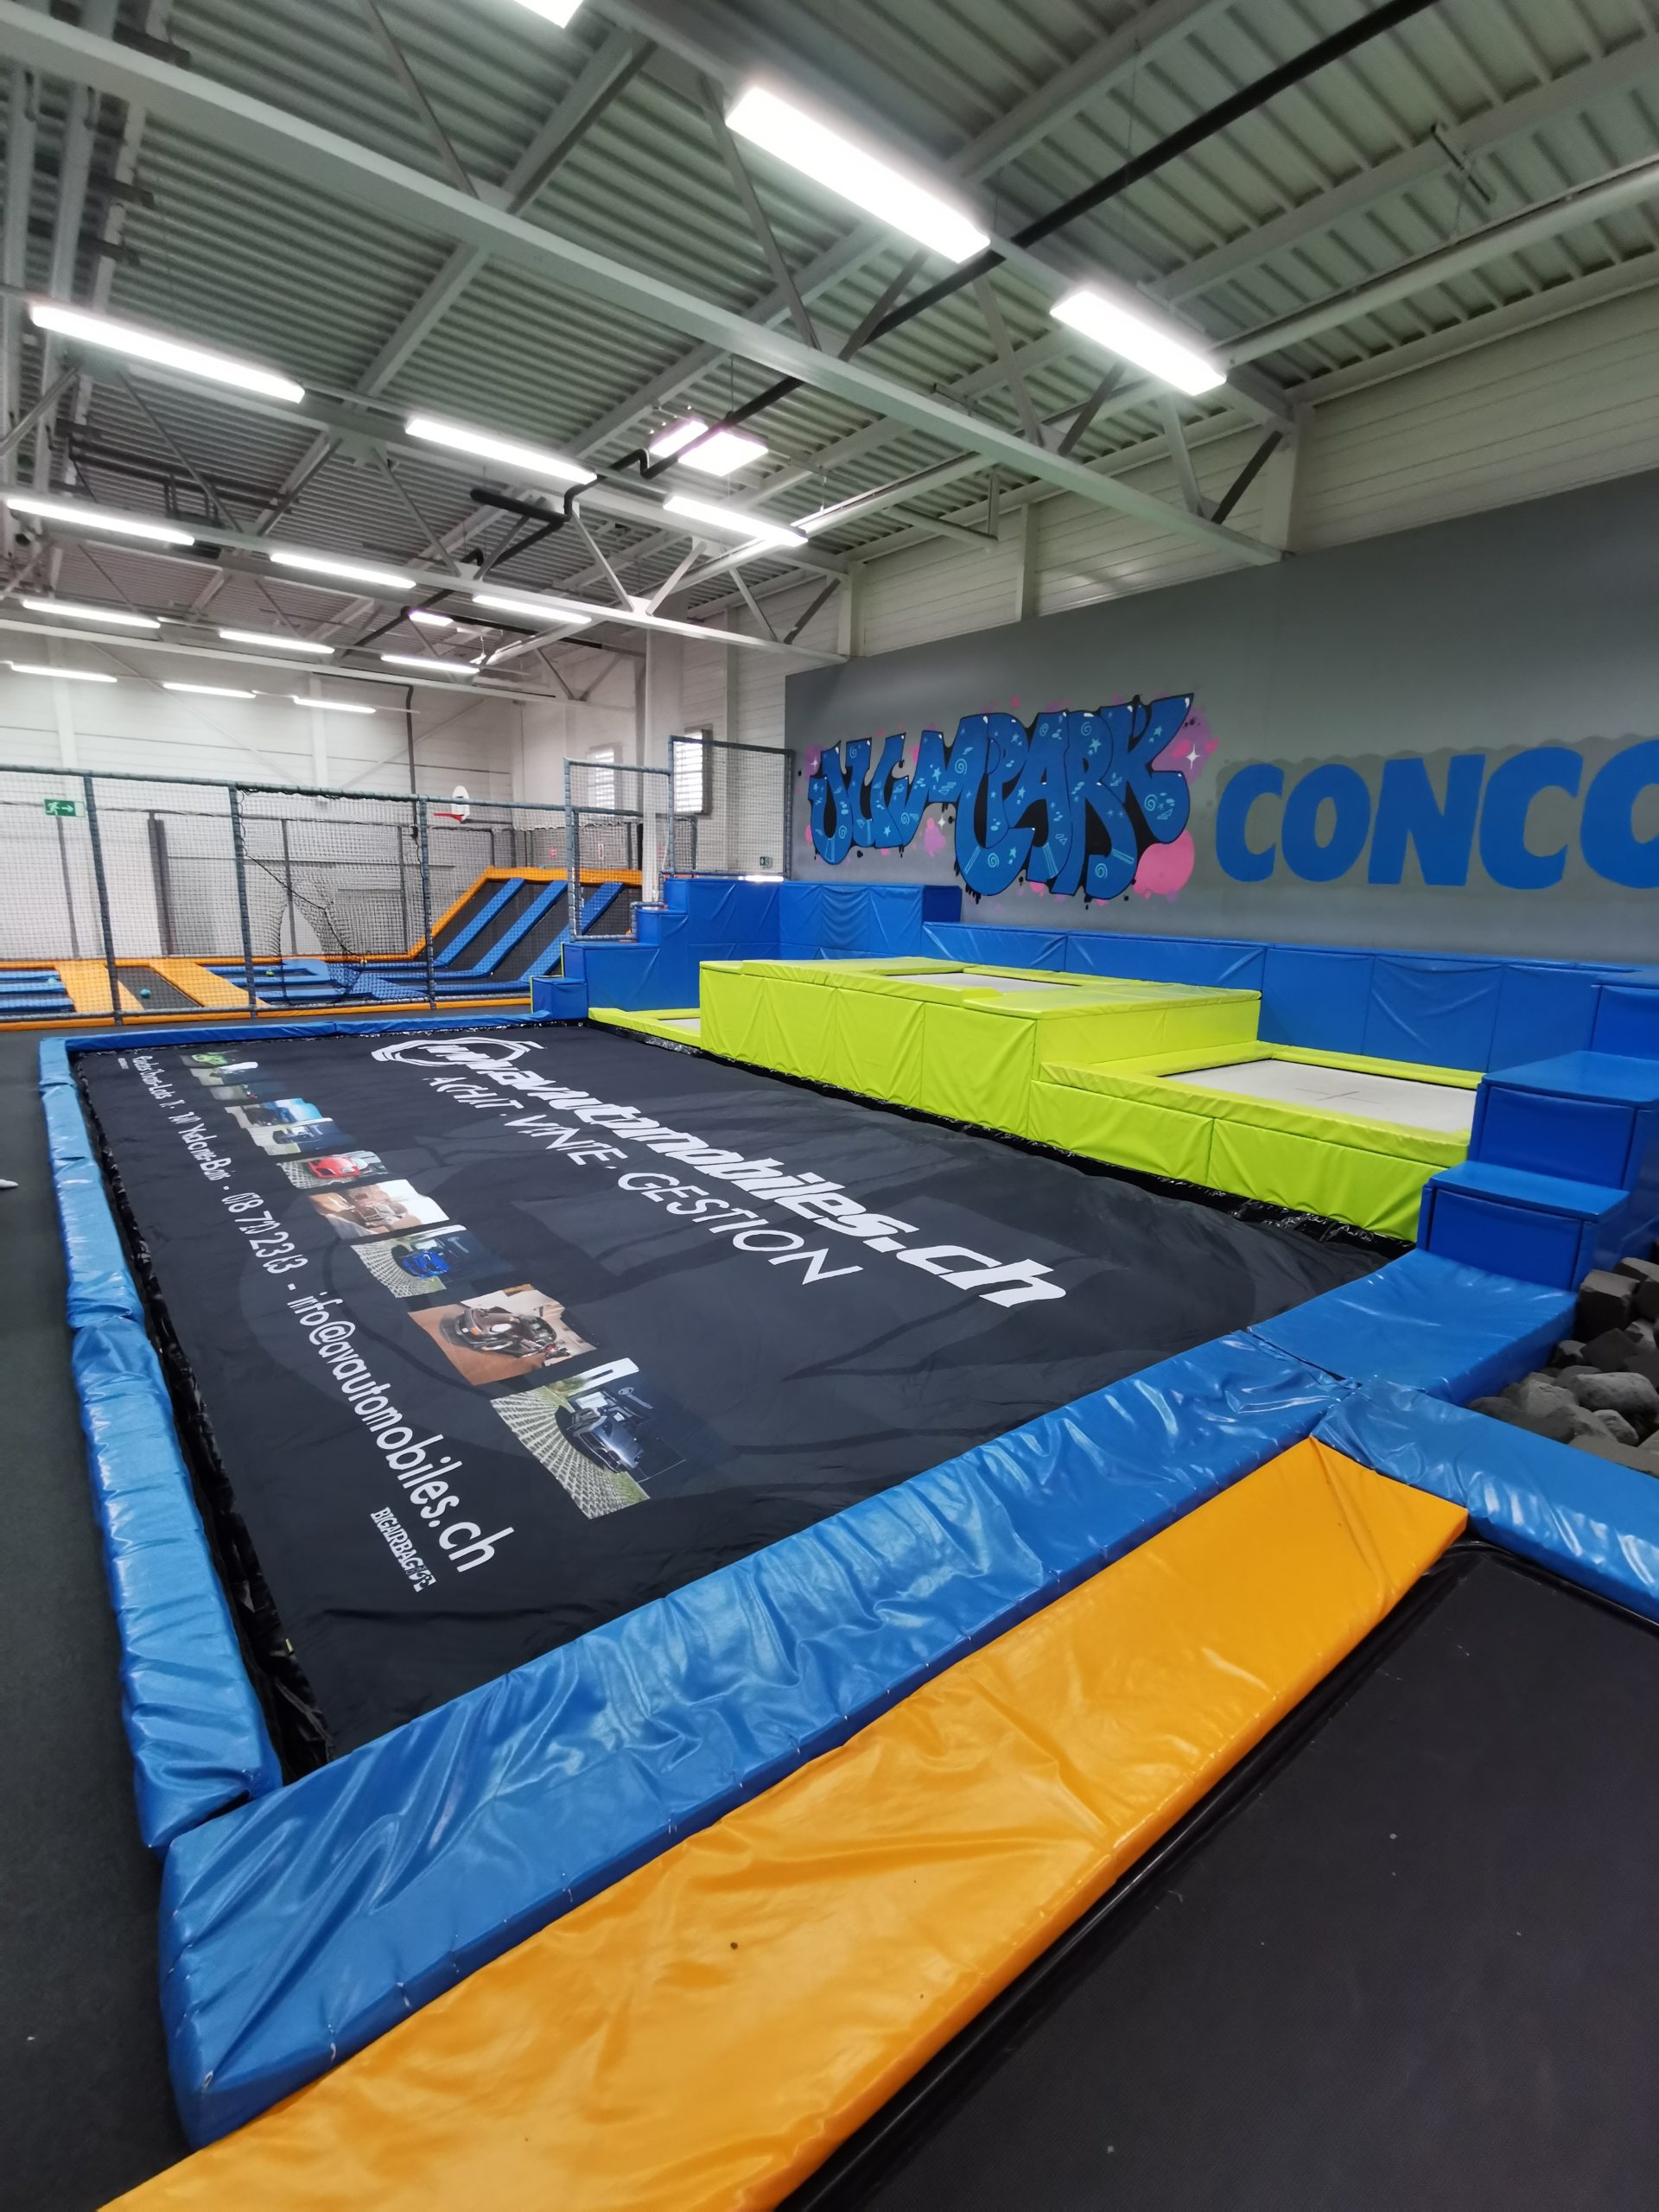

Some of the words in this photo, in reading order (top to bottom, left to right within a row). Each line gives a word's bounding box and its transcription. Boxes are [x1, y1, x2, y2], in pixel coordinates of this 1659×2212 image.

[617, 1172, 864, 1285] GESTION
[249, 1231, 296, 1258] 23
[287, 1291, 515, 1573] info@avautomobiles.ch
